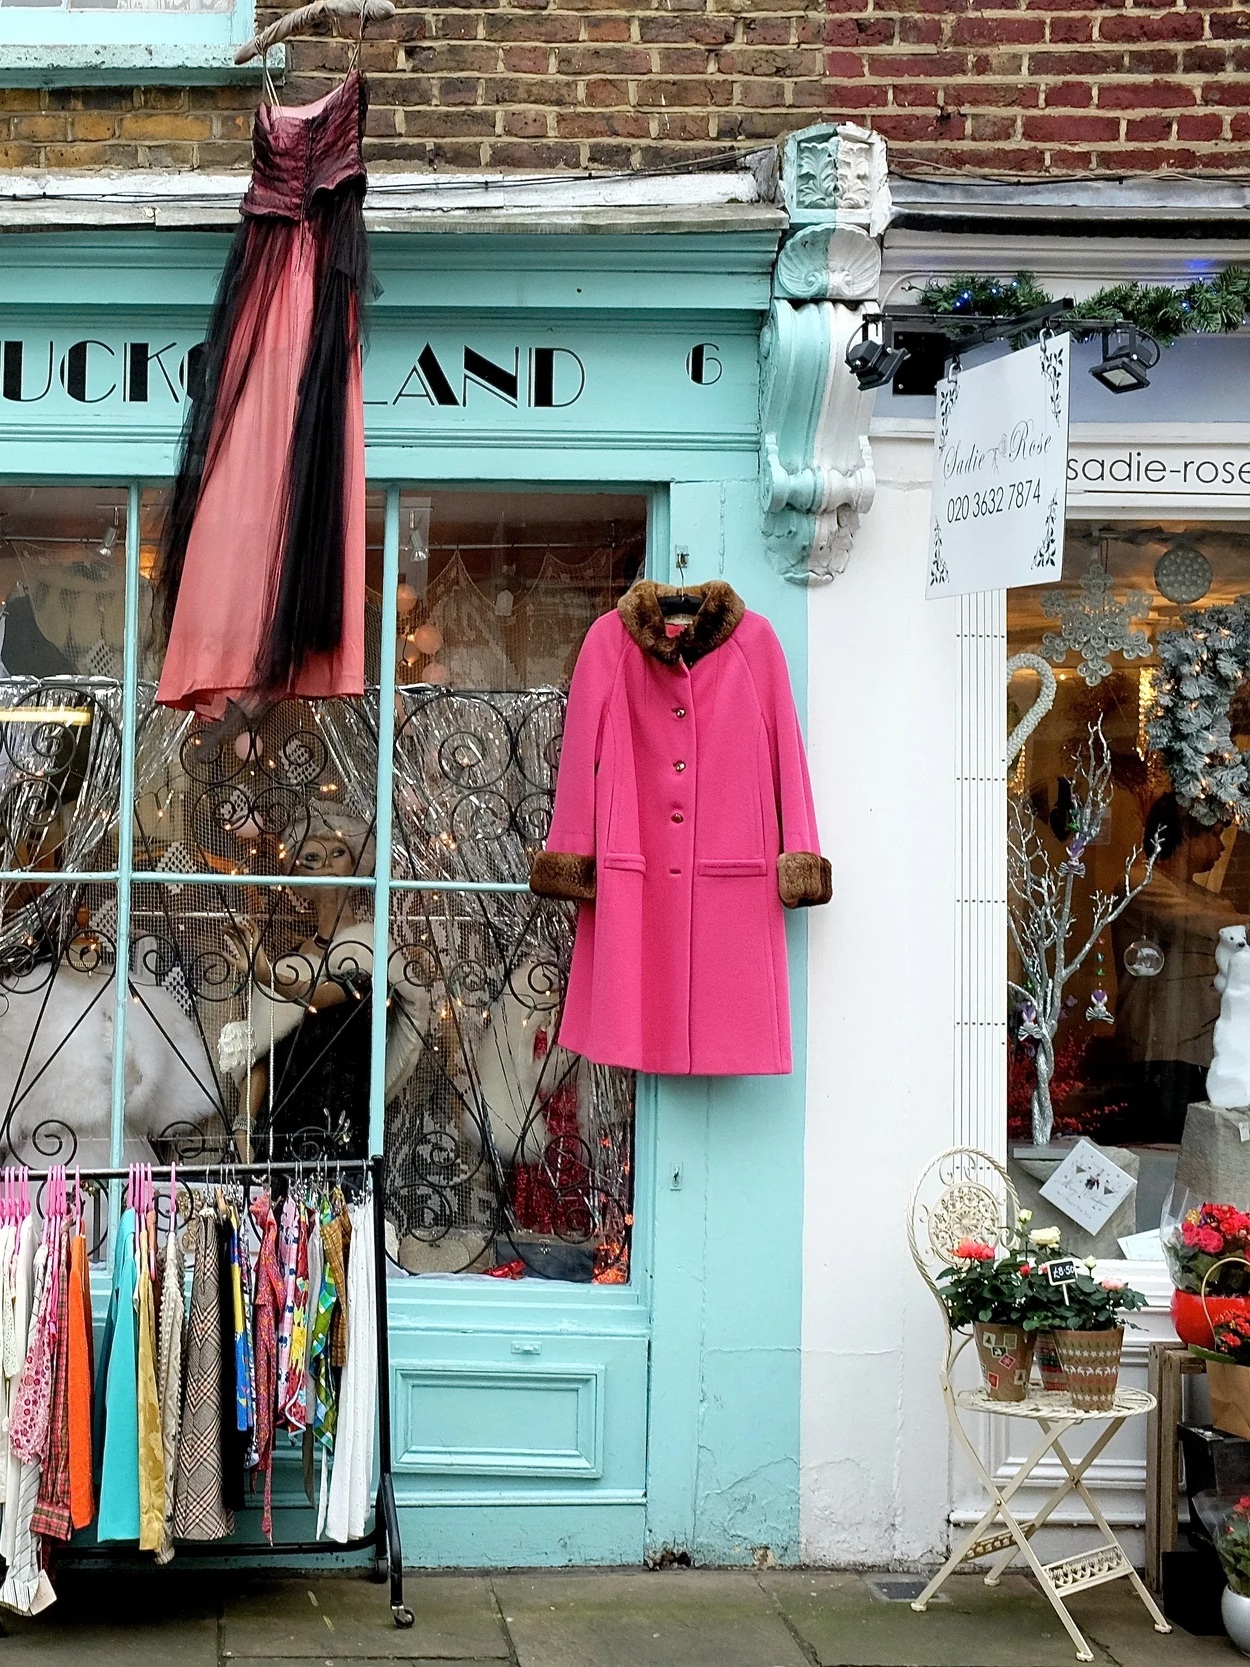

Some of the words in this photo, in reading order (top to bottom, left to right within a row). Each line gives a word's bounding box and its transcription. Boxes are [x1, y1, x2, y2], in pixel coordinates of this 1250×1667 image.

[686, 342, 723, 385] 6
[944, 440, 985, 480] Sadie
[1009, 418, 1051, 463] Rose
[947, 498, 970, 523] 020
[972, 486, 1004, 518] 3632
[1008, 478, 1041, 510] 7874
